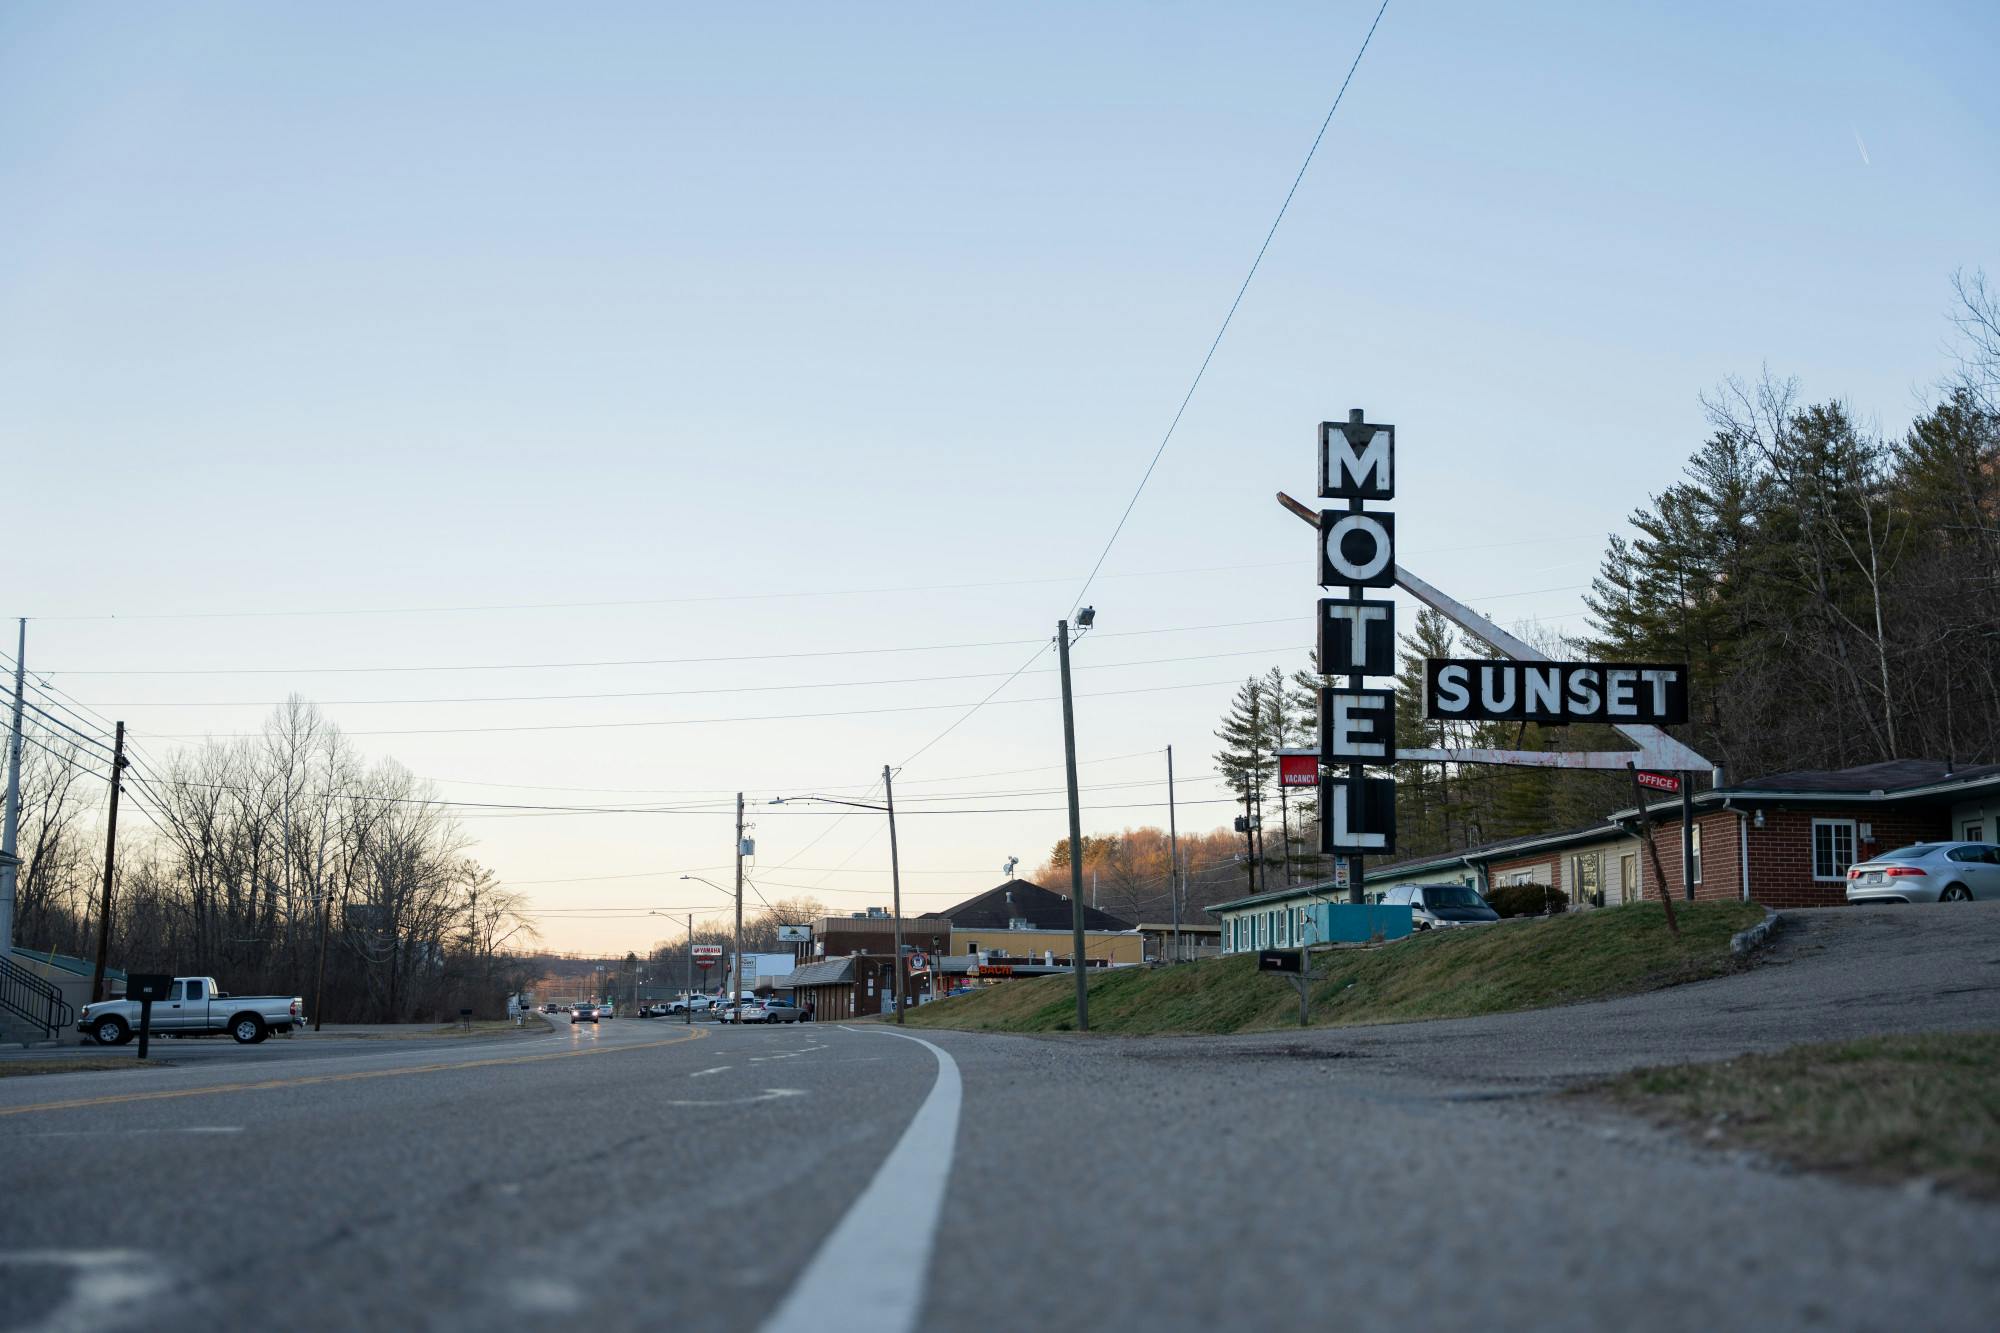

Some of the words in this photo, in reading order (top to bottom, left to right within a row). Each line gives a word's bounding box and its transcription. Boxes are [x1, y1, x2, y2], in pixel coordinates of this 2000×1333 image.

[1326, 427, 1391, 848] MOTEL
[1437, 665, 1677, 716] SUNSET
[1284, 774, 1315, 783] VACANCY
[1637, 774, 1673, 788] OFFICE
